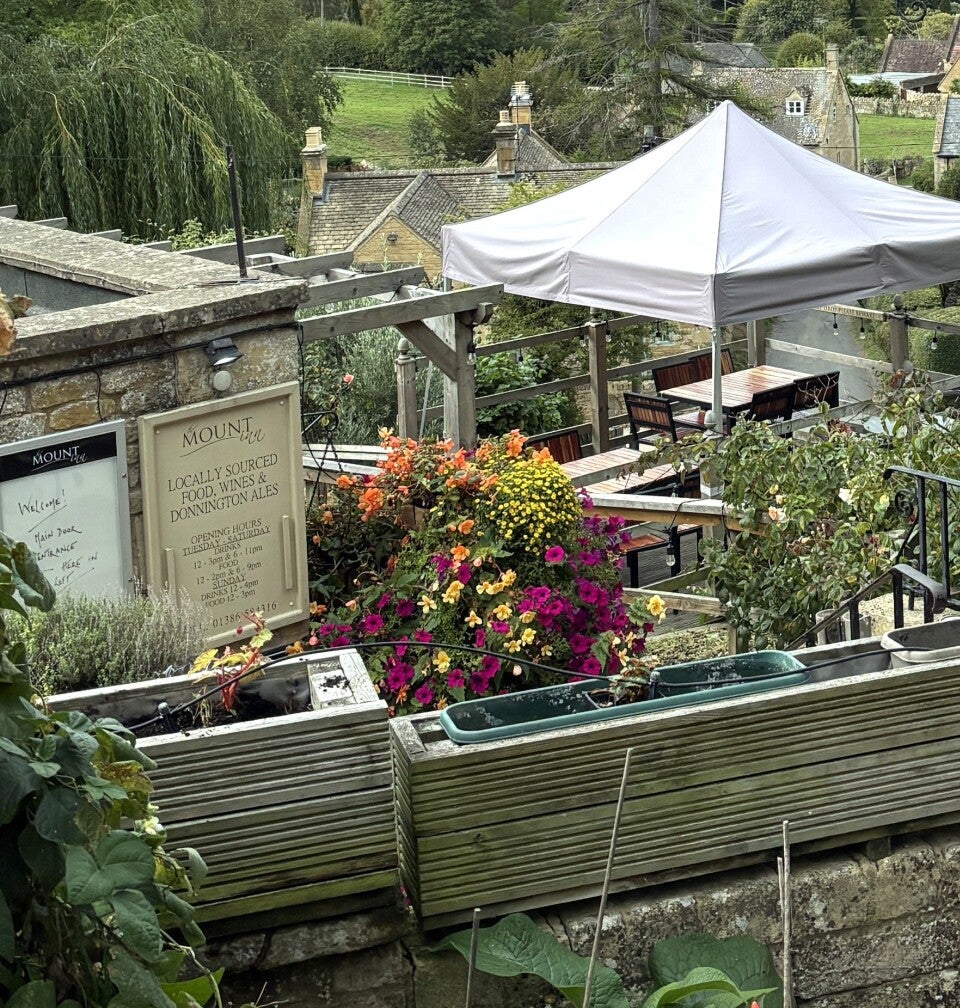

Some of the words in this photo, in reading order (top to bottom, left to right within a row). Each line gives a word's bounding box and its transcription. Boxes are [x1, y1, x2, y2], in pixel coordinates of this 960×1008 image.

[182, 417, 253, 447] MOUNT
[32, 445, 79, 466] MOUNT
[168, 467, 222, 492] LOCALLY
[225, 453, 278, 477] SOURCED
[219, 474, 255, 493] WINES
[258, 471, 267, 484] &
[170, 491, 248, 523] DONNINGTON
[251, 483, 279, 502] ALES
[182, 539, 221, 556] TUESDAY
[227, 525, 271, 543] SATURDAY
[191, 527, 230, 544] OPENING
[232, 518, 262, 534] HOURS
[214, 542, 241, 555] DRINKS
[194, 561, 202, 569] 12
[197, 576, 205, 585] 12
[247, 561, 262, 571] 9pm
[219, 559, 239, 570] FOOD
[201, 587, 228, 601] DRINKS
[230, 584, 238, 593] 12
[244, 579, 259, 589] 4pm
[212, 573, 246, 589] SUNDAY
[205, 597, 225, 608] FOOD
[228, 593, 235, 602] 12
[212, 612, 241, 628] 01386
